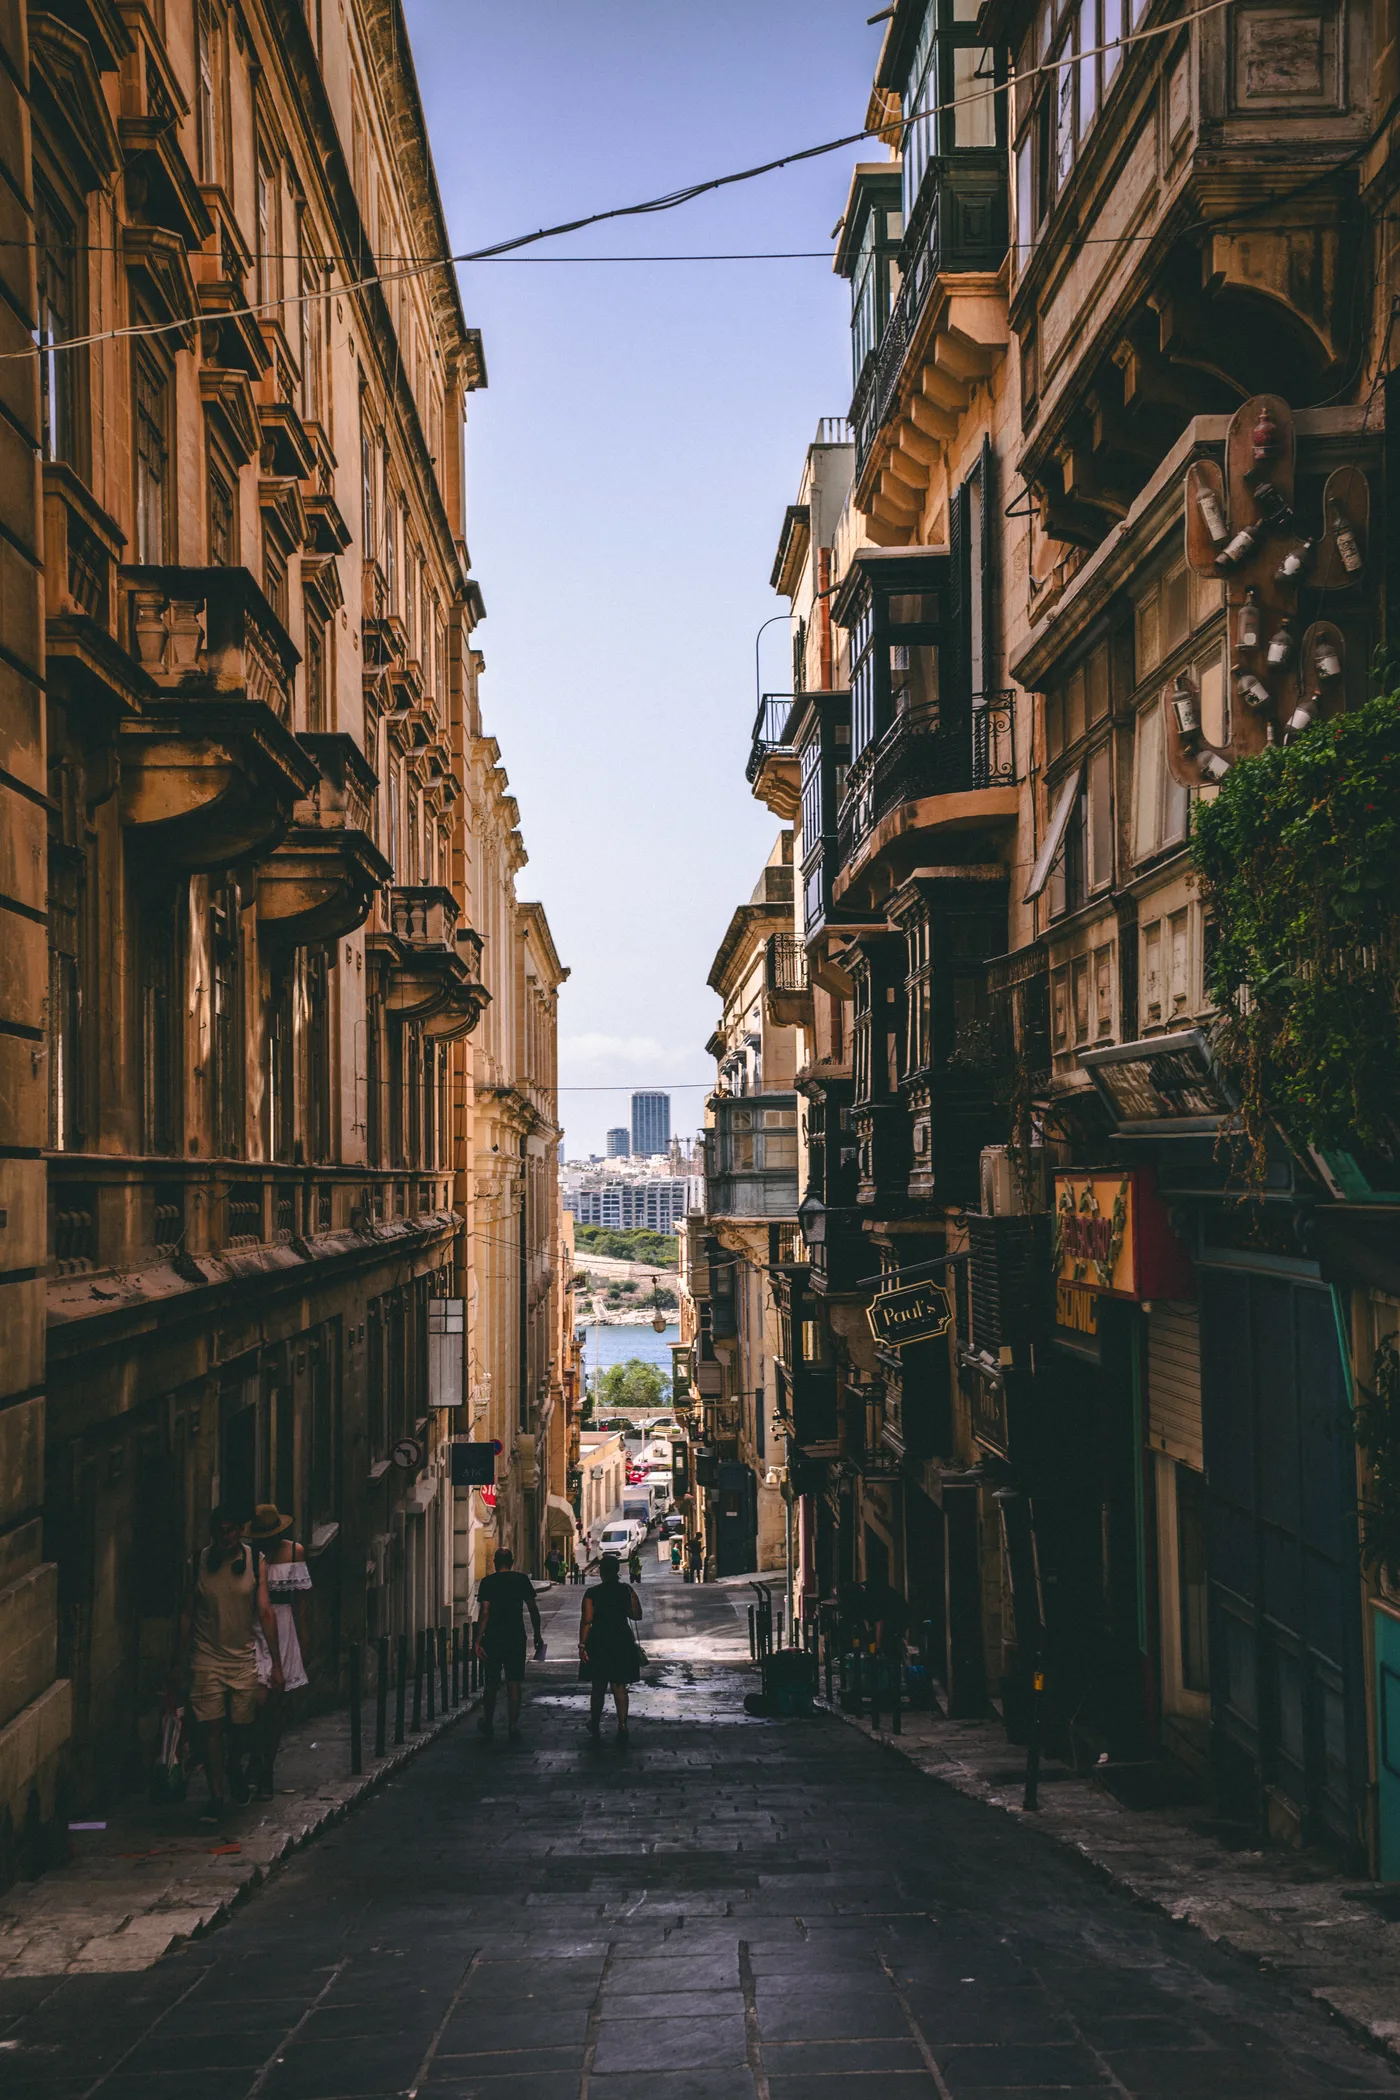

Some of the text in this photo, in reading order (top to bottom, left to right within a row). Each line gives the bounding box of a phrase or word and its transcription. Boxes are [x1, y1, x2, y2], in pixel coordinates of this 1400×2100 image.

[1117, 1086, 1218, 1115] SHOE STORE
[883, 1299, 936, 1326] Paul's
[1056, 1287, 1097, 1335] SONIC
